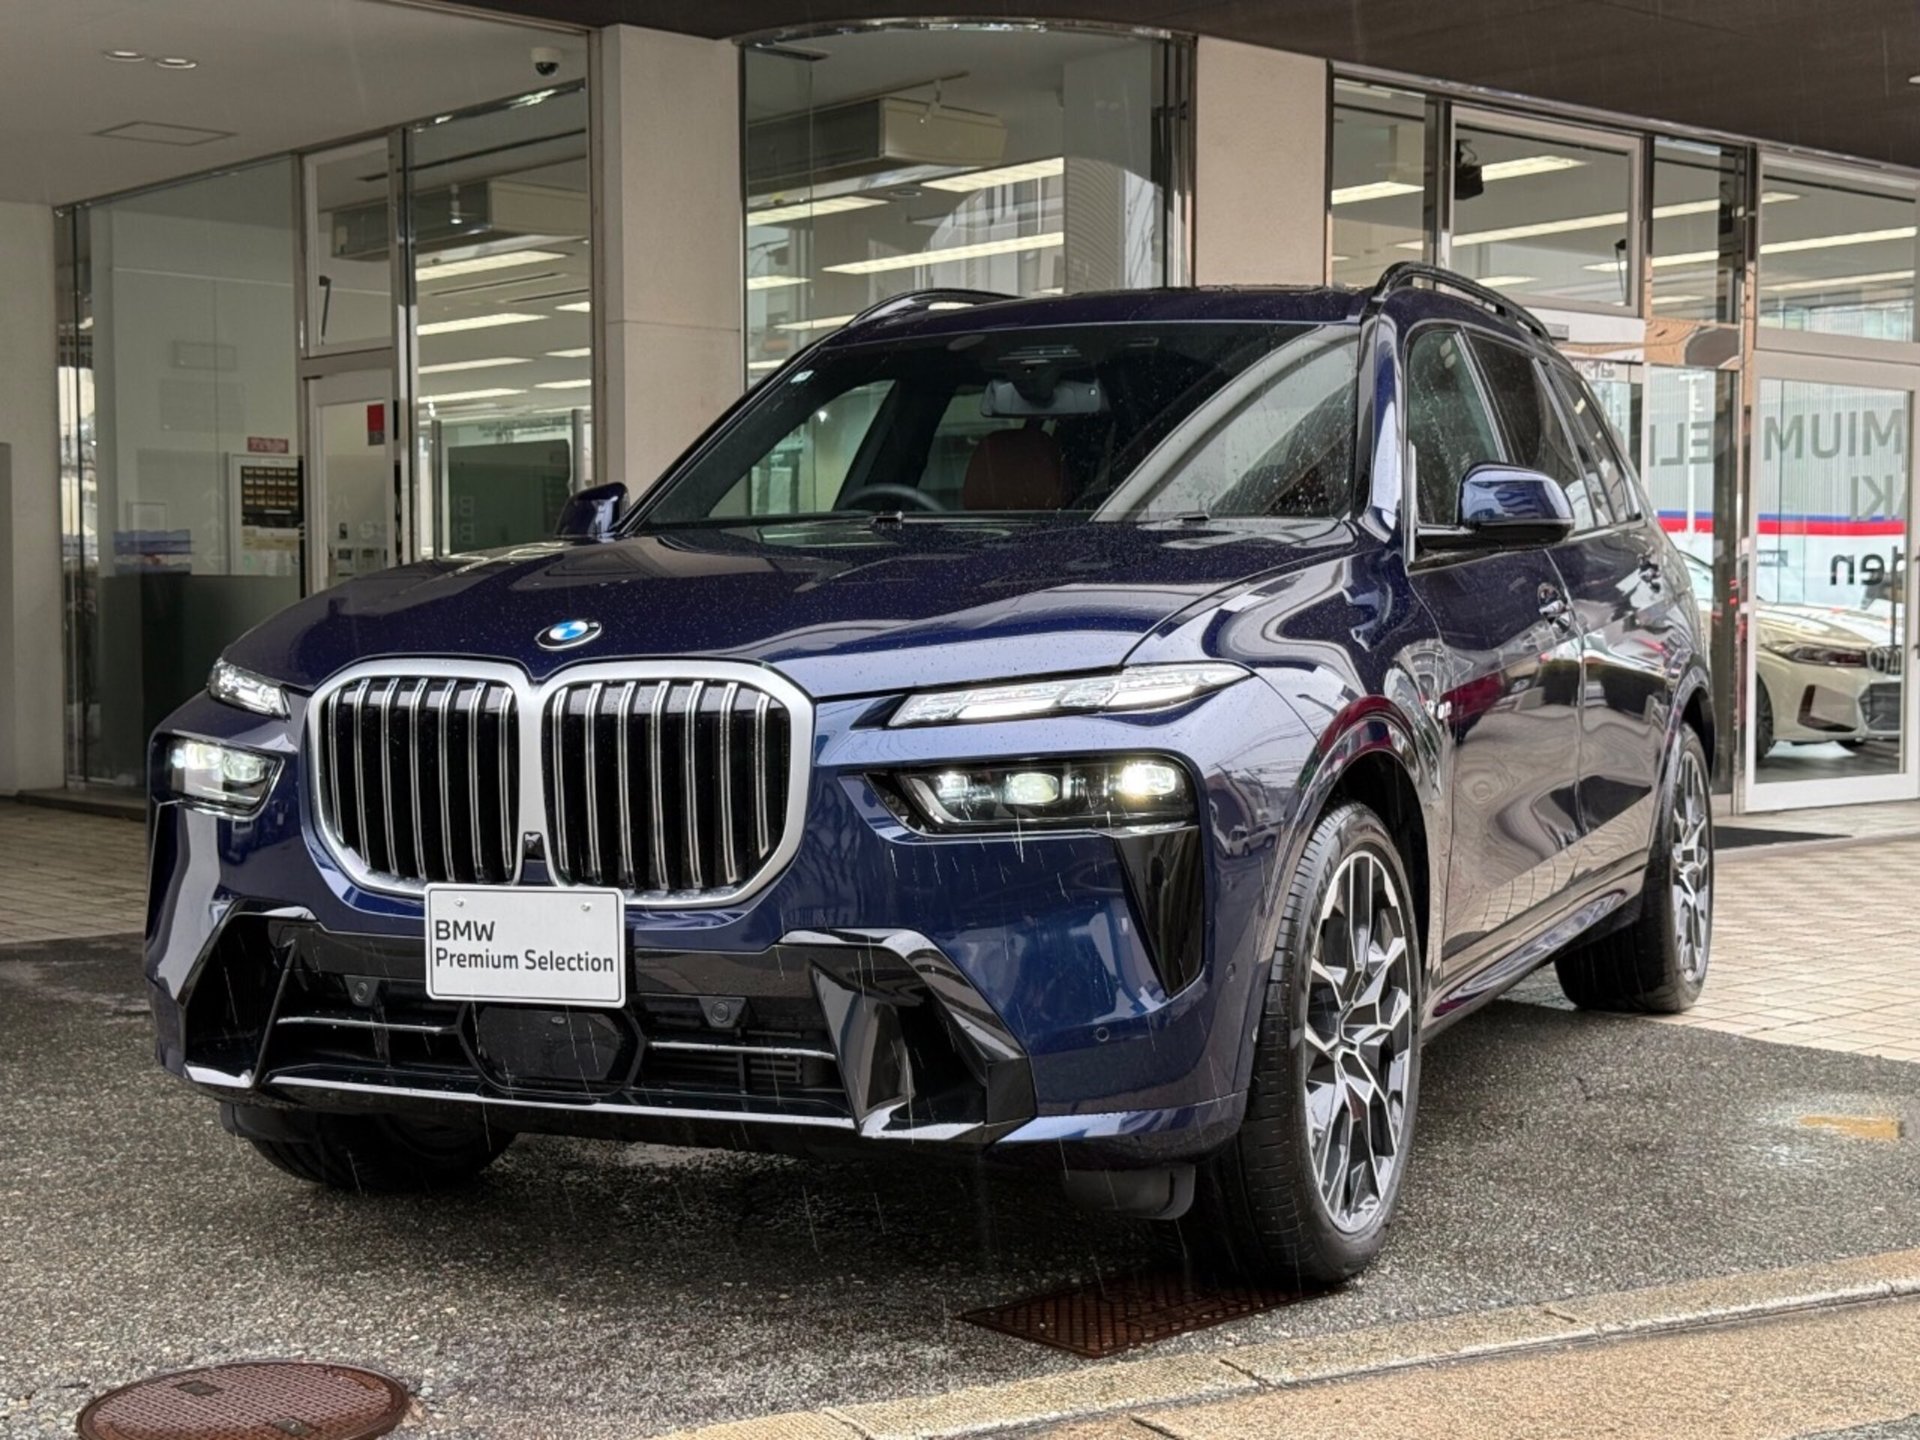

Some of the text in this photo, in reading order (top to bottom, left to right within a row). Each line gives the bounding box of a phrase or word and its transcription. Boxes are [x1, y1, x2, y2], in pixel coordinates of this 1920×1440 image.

[435, 919, 495, 942] BMW
[435, 947, 614, 973] Premium Selection
